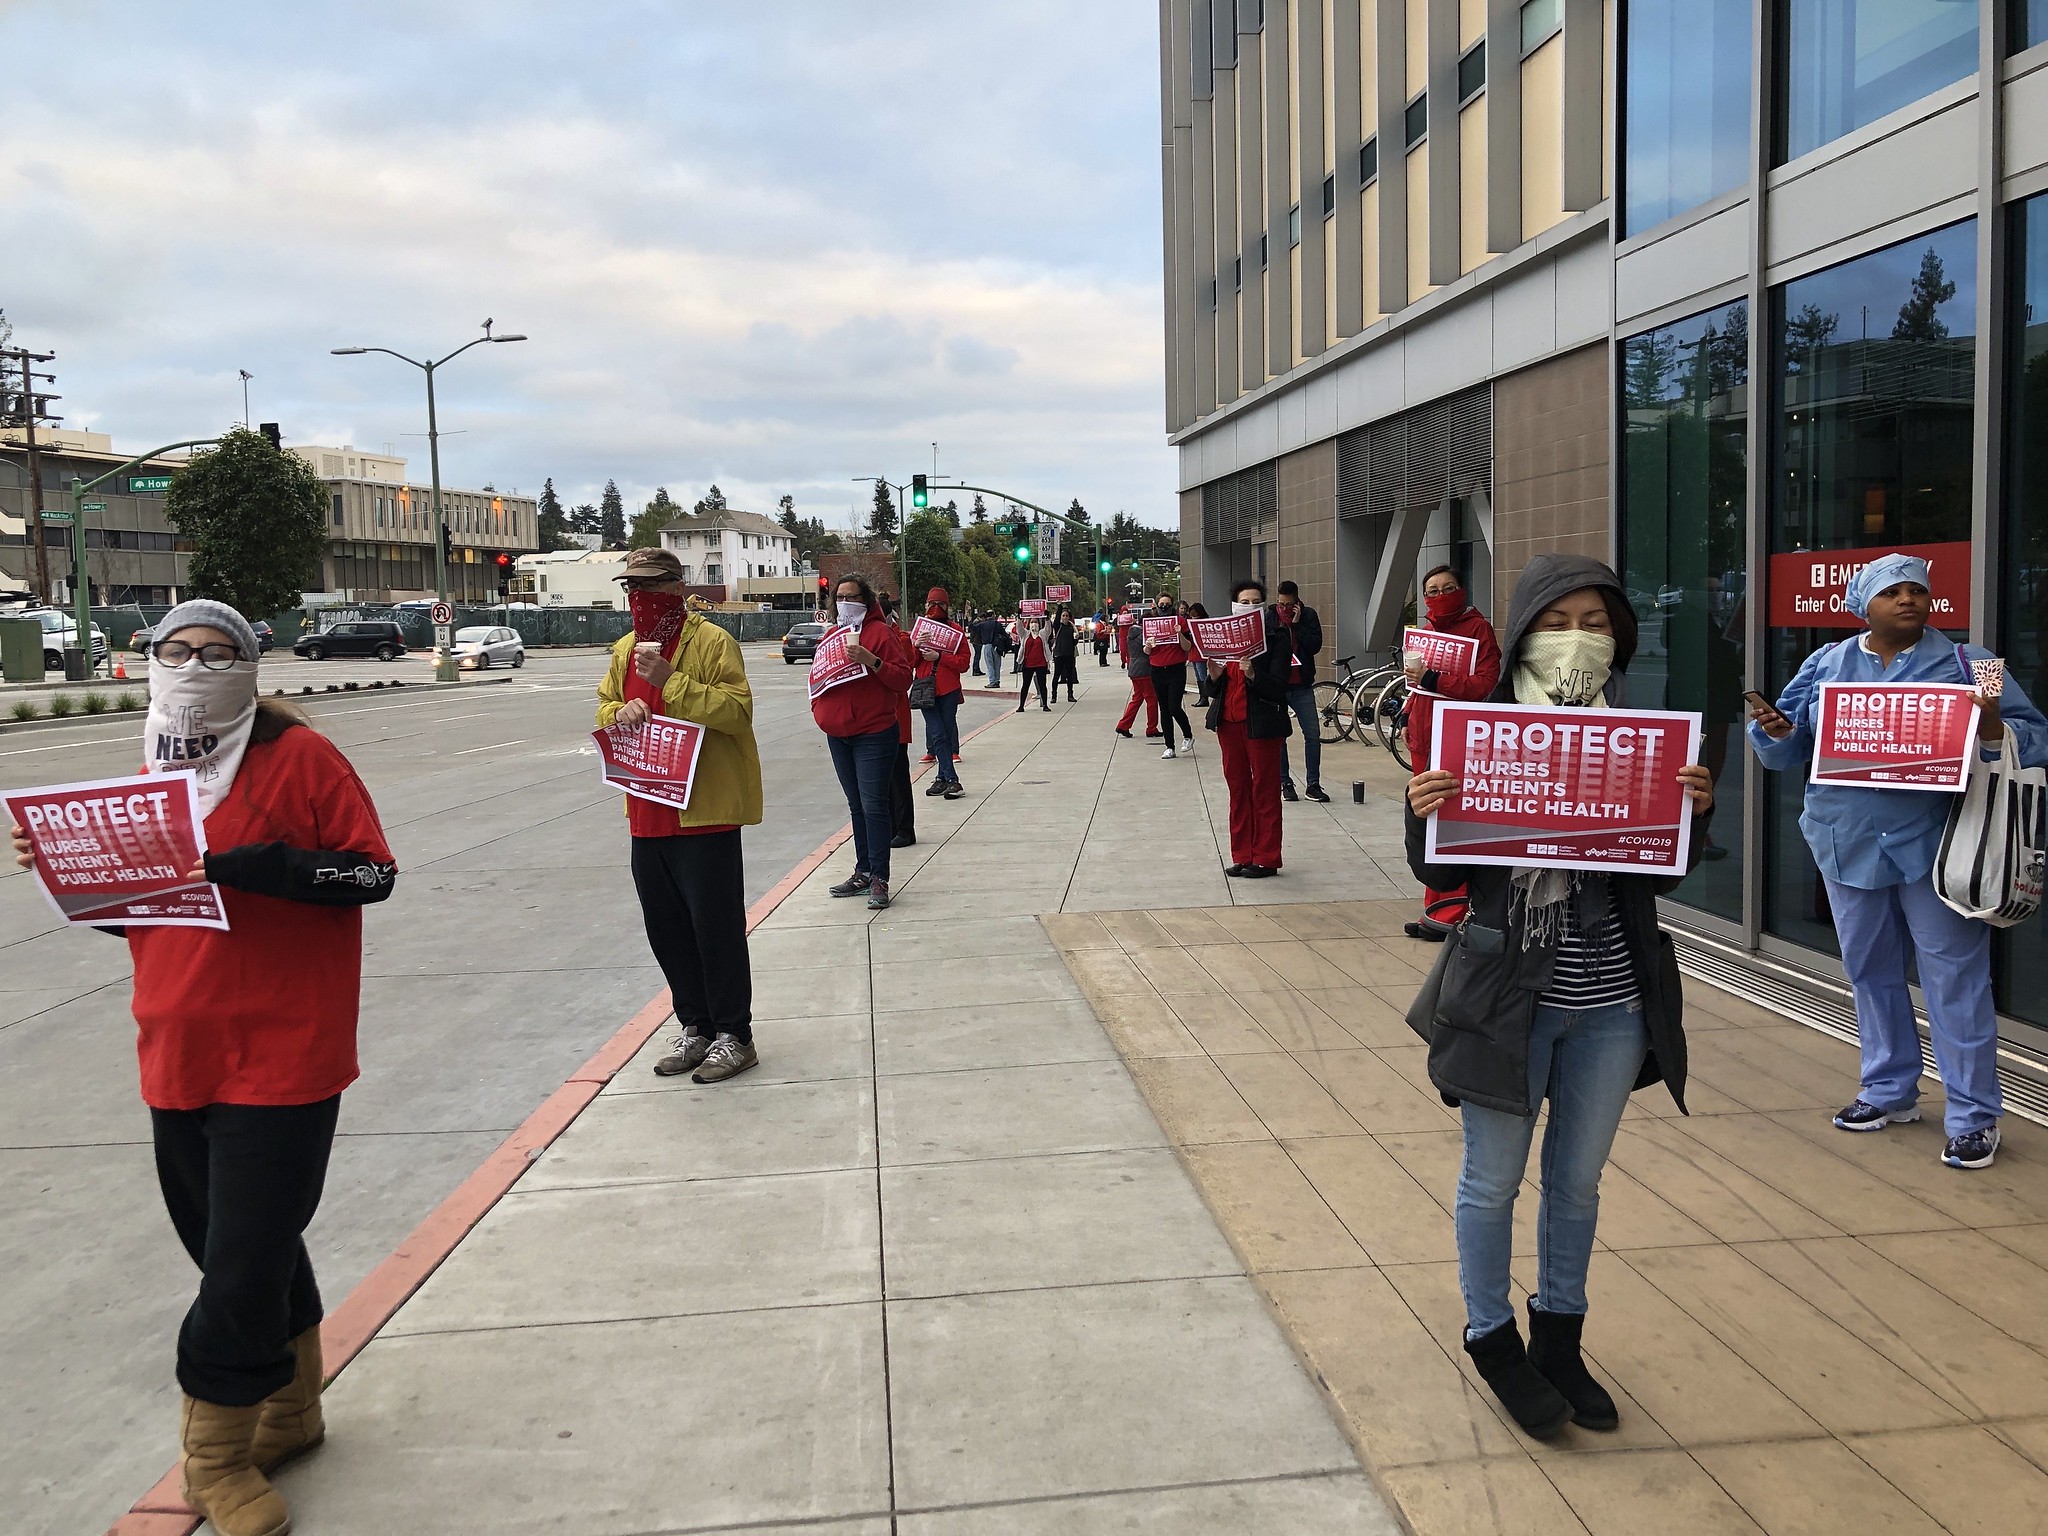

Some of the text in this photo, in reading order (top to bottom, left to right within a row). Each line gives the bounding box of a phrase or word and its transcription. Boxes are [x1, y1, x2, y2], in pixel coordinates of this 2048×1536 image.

[1796, 595, 1825, 612] Enter
[920, 621, 956, 636] PROTECT
[1198, 616, 1254, 631] PROTECT
[1226, 640, 1251, 648] HEALTH
[1409, 635, 1465, 655] PROTECT
[1555, 667, 1593, 701] WE
[1836, 693, 1957, 712] PROTECT
[163, 704, 208, 735] WE
[1835, 719, 1884, 728] NURSES
[604, 722, 687, 744] PROTECT
[1466, 720, 1665, 757] PROTECT
[1834, 730, 1894, 741] PATIENTS
[156, 734, 219, 761] NEED
[610, 736, 640, 748] NURSES
[1834, 742, 1932, 754] PUBLIC HEALTH
[612, 744, 645, 760] PATIENTS
[613, 753, 668, 776] PUBLIC HEALTH
[1464, 760, 1550, 778] NURSES
[1462, 778, 1567, 797] PATIENTS
[24, 792, 168, 832] PROTECT
[1461, 796, 1629, 819] PUBLIC HEALTH
[40, 838, 102, 854] NURSES
[1618, 836, 1672, 847] #COVID19
[48, 854, 123, 871] PATIENTS
[57, 865, 177, 886] PUBLIC HEALTH
[181, 893, 214, 903] #COVID19
